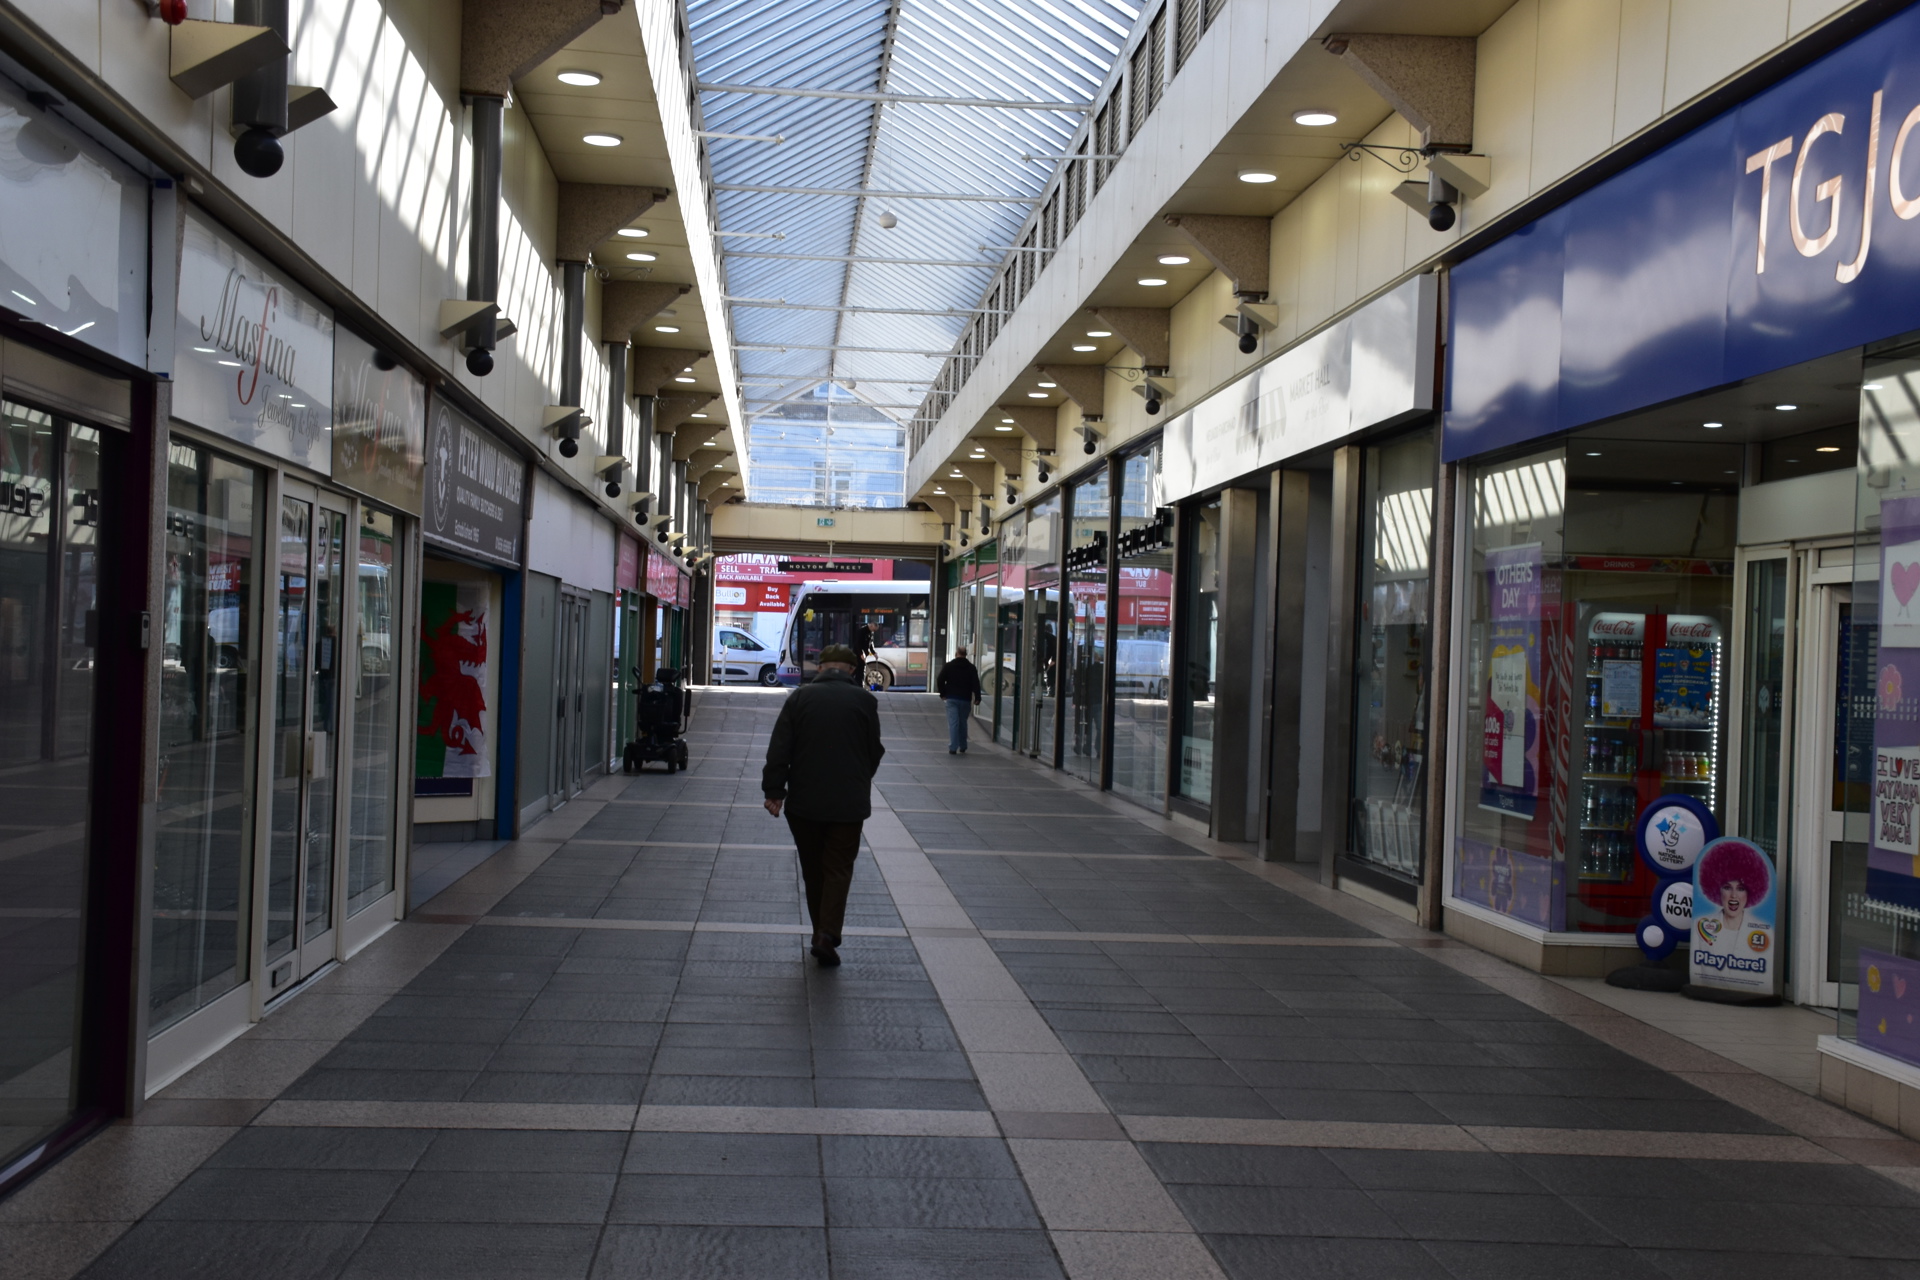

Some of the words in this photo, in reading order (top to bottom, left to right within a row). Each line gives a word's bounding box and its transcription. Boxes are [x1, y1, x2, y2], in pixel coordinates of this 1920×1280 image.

[200, 267, 296, 405] Masfina
[1289, 371, 1315, 403] MARKET
[1315, 363, 1331, 391] HALL
[257, 384, 297, 442] Jewellery
[458, 424, 479, 481] PETER
[479, 438, 497, 491] WOOD
[496, 450, 522, 505] BUTCHERS
[721, 565, 740, 573] SELL
[759, 566, 787, 575] TRA
[1603, 561, 1636, 569] DRINKS
[1501, 587, 1520, 609] DAY
[1593, 619, 1637, 636] Coca-Cola
[1670, 622, 1714, 638] Coca-Cola
[1484, 717, 1500, 734] 100s
[1880, 800, 1914, 826] VERY
[1880, 822, 1912, 846] MUCH
[1658, 851, 1685, 860] NATIONAL
[1665, 847, 1677, 855] THE
[1659, 856, 1683, 865] LOTTERY
[1752, 934, 1765, 945] £1
[1695, 951, 1725, 968] Play
[1728, 955, 1764, 971] here!
